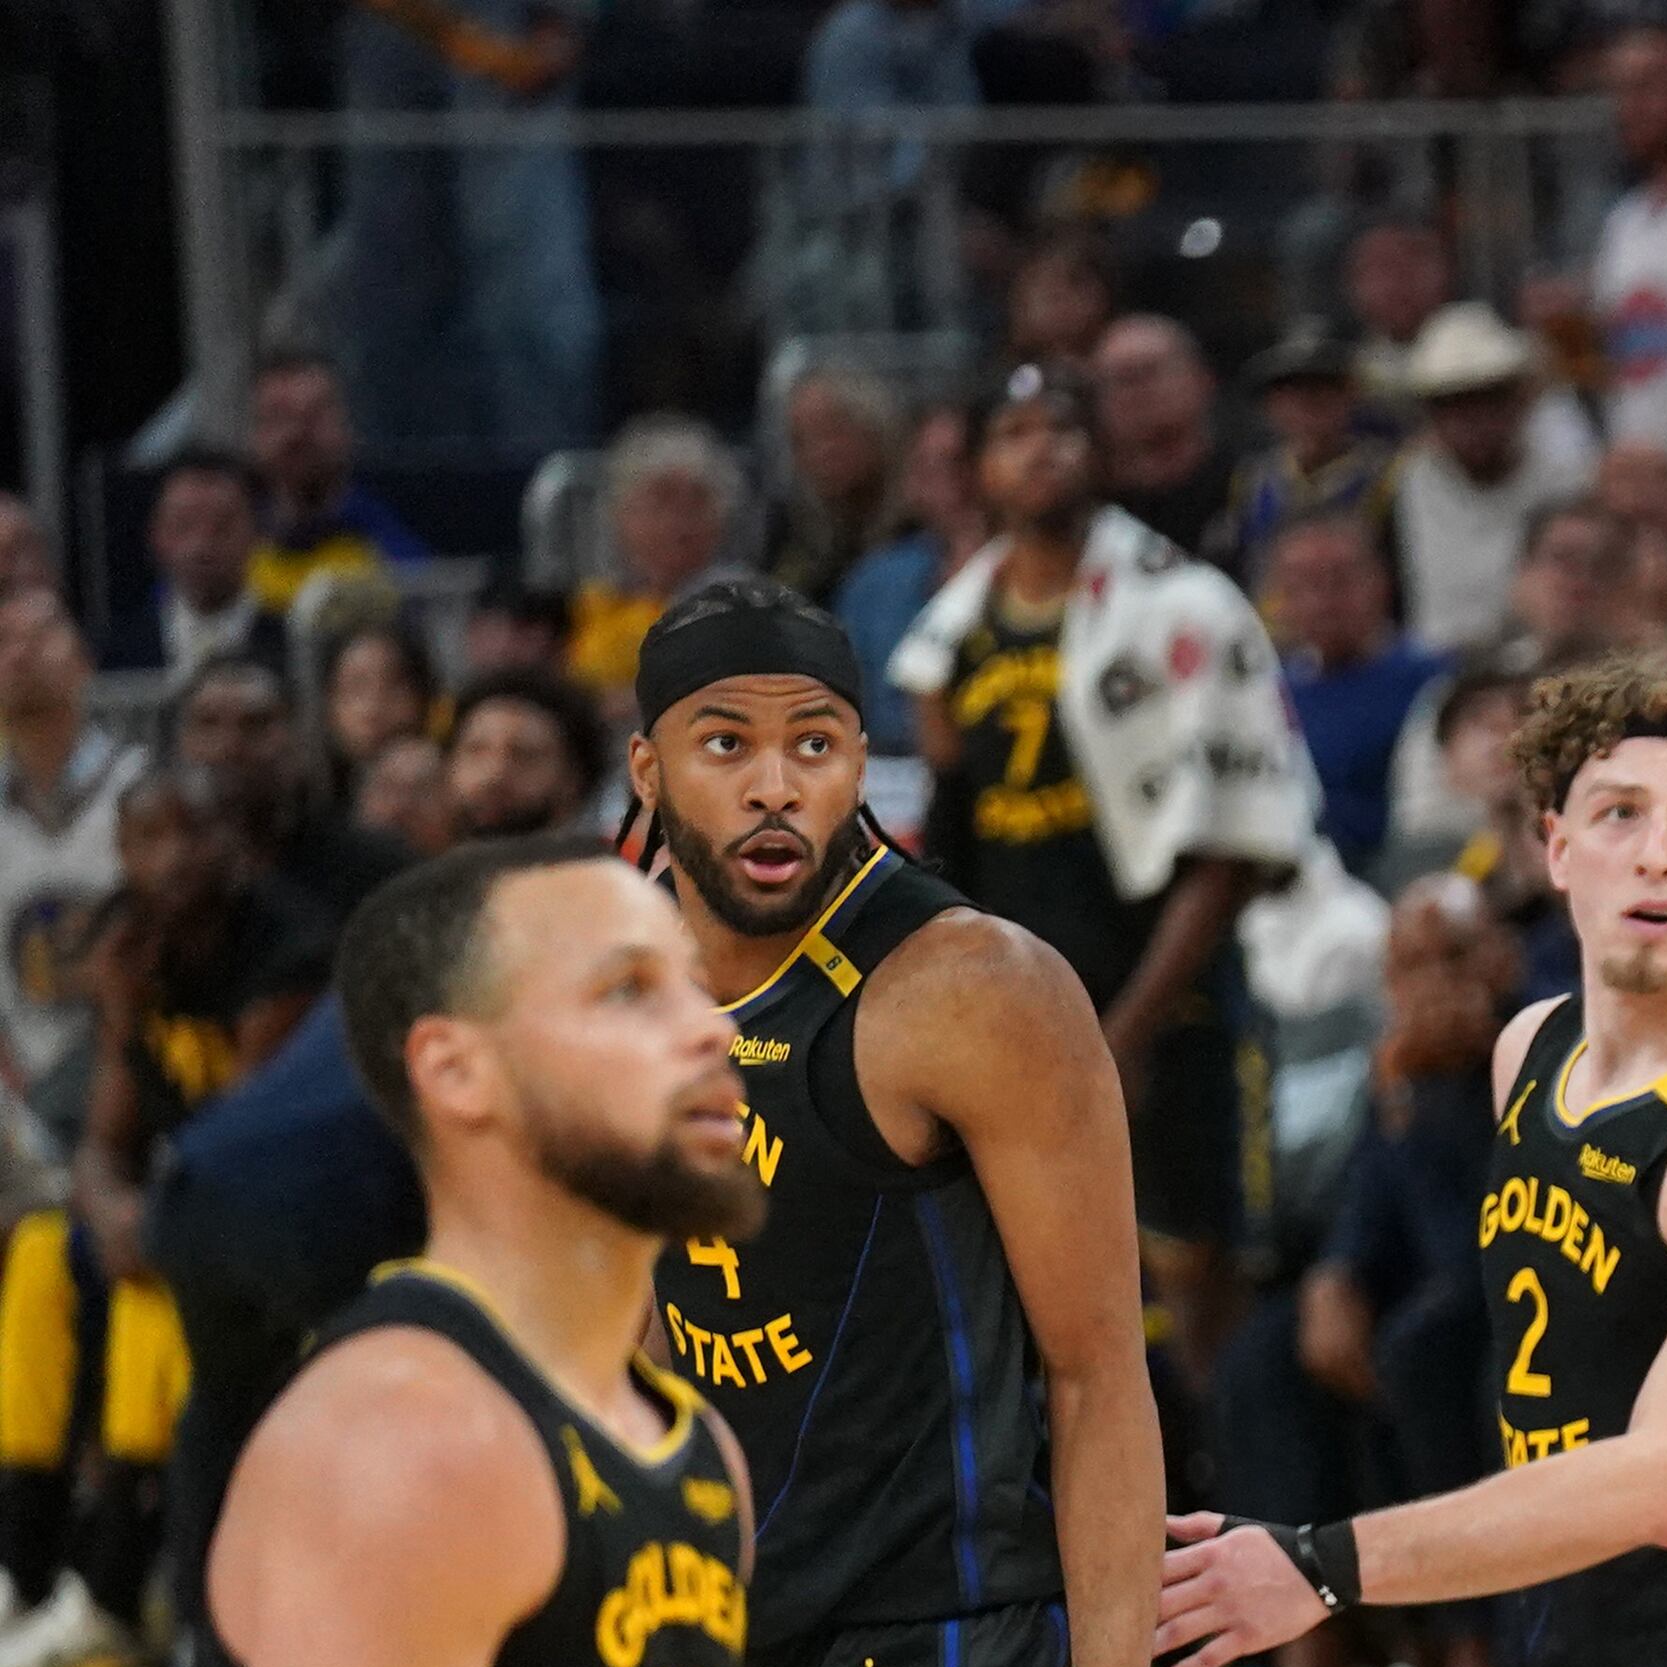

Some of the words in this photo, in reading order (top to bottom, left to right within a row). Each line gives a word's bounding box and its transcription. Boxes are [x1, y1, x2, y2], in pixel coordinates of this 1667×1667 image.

[728, 1034, 791, 1062] Rakuten
[1578, 1143, 1637, 1184] Rakuten
[1478, 1175, 1622, 1295] GOLDEN
[666, 1301, 814, 1389] STATE
[1505, 1266, 1552, 1398] 2
